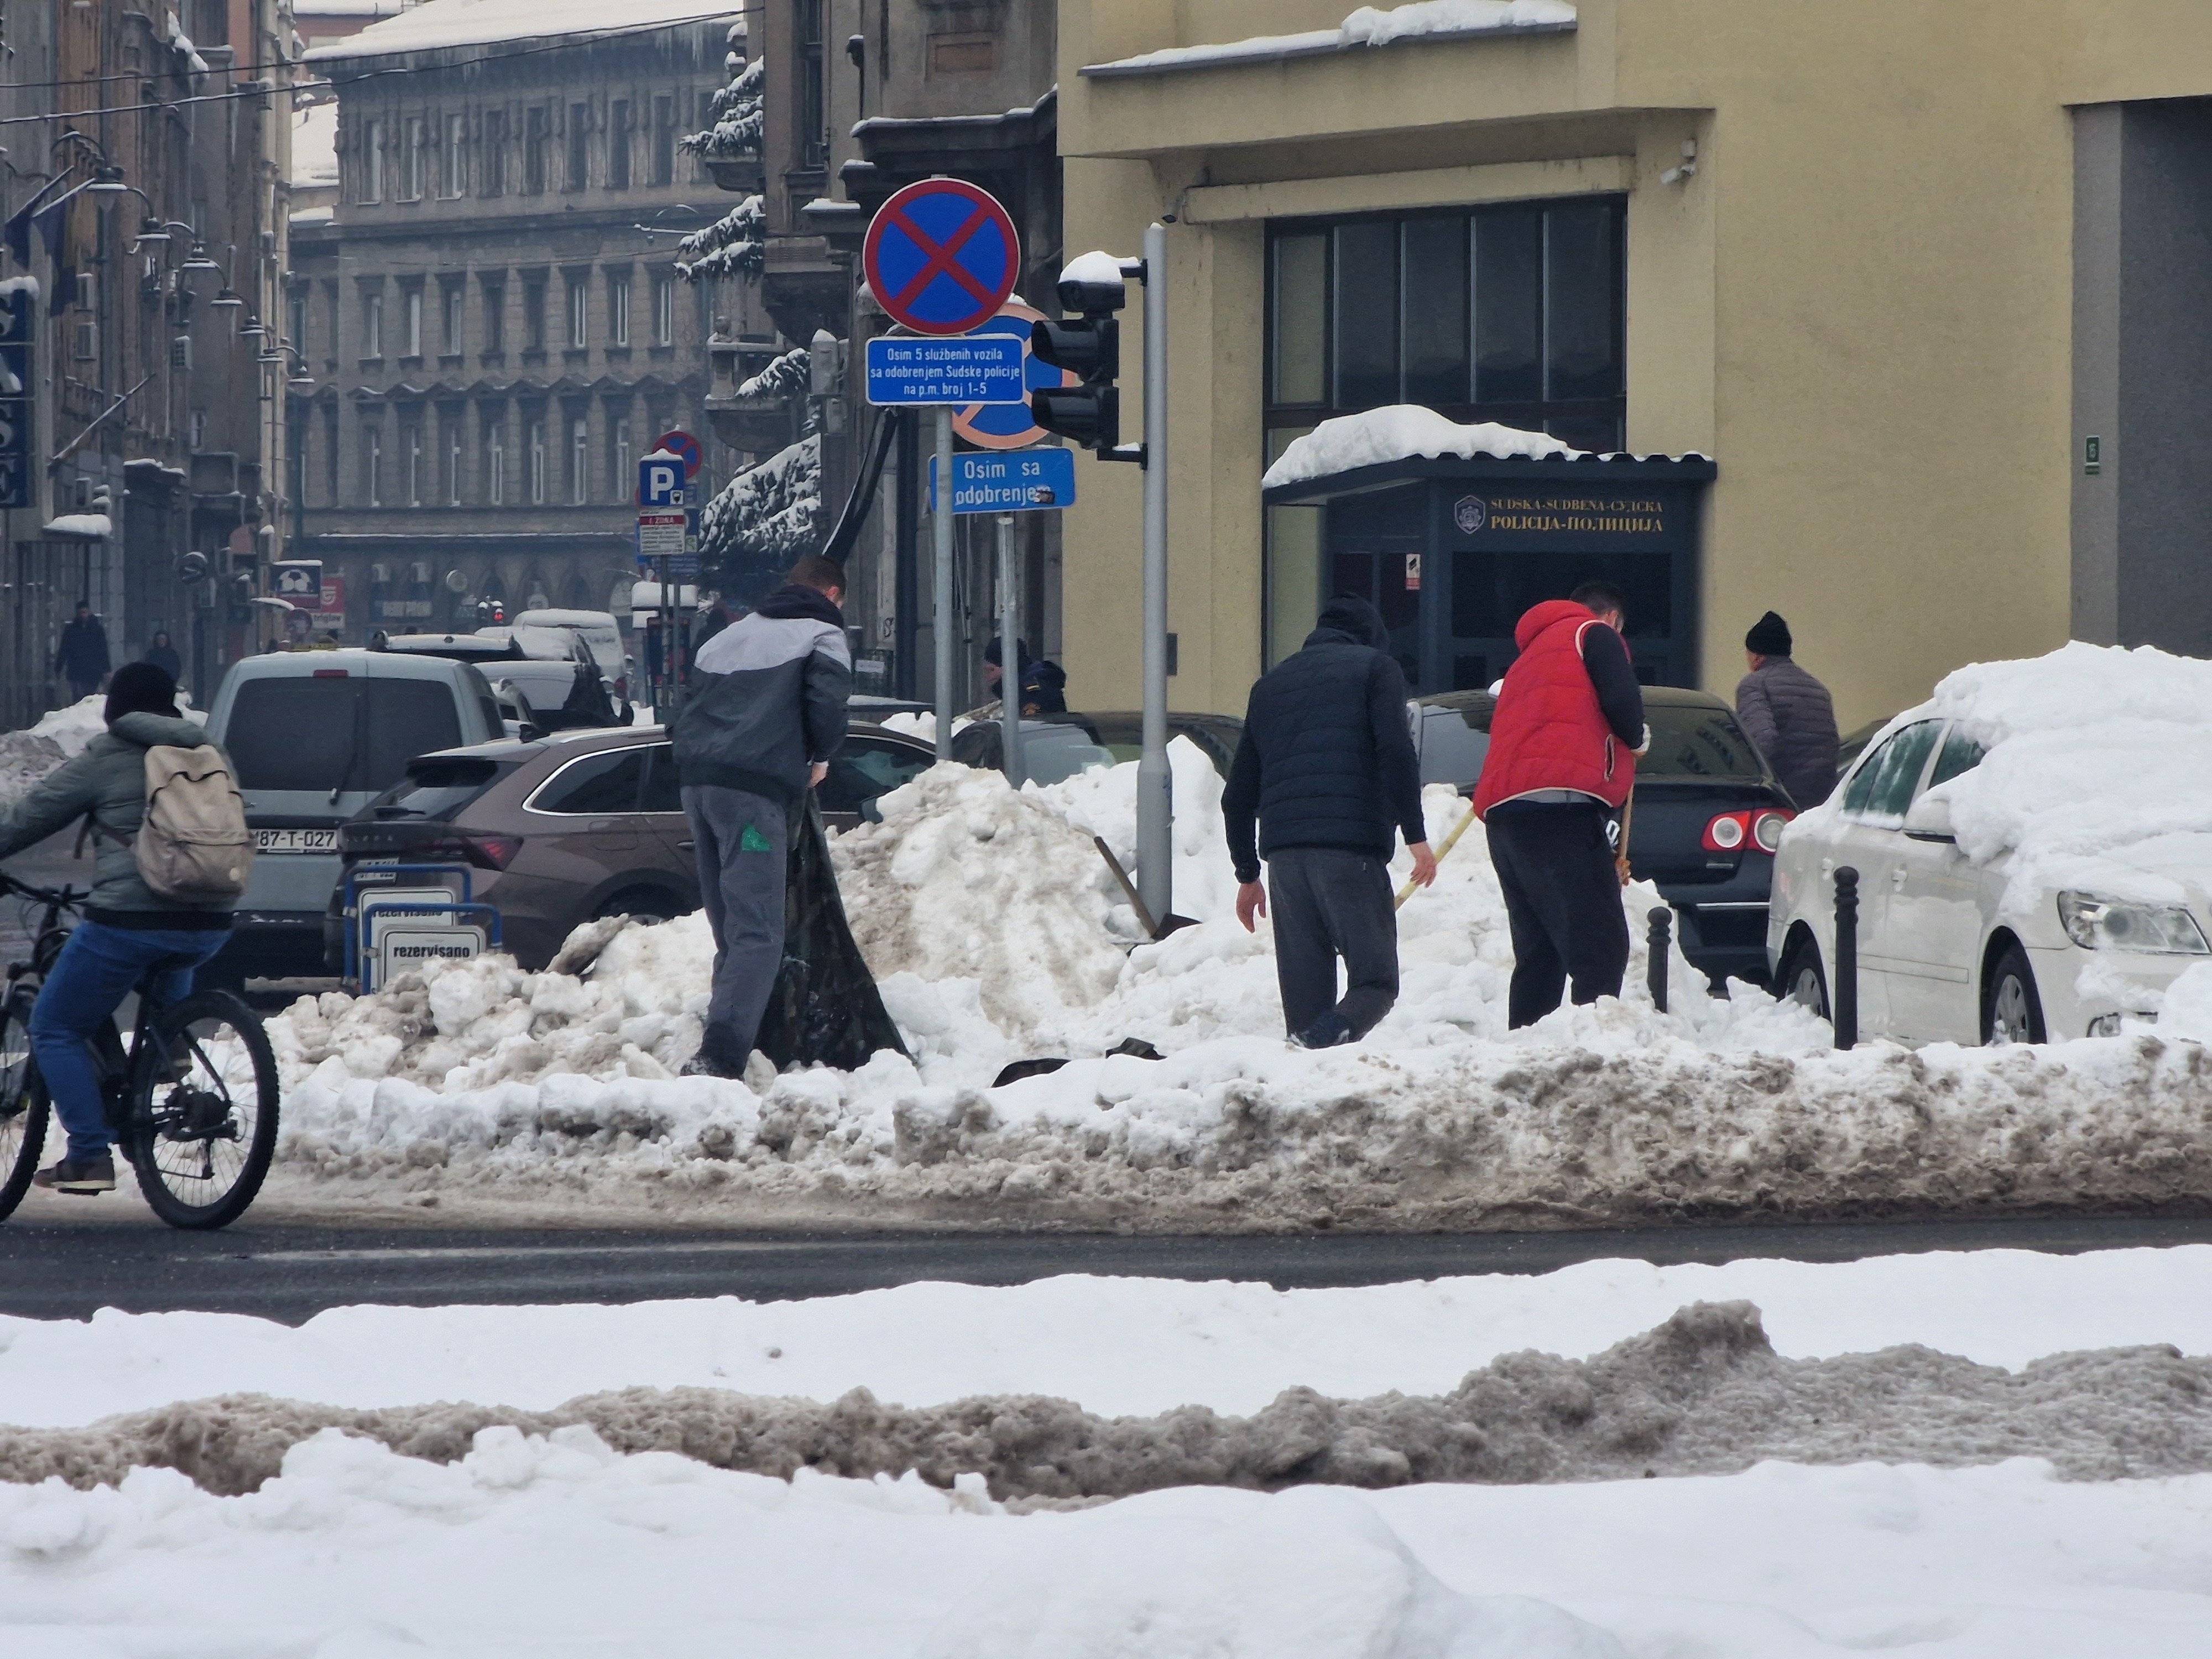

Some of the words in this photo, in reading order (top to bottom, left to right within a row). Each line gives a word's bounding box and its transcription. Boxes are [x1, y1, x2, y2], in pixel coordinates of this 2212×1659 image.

[887, 348, 912, 361] Osim
[915, 348, 922, 361] 5
[925, 347, 971, 361] službenih
[974, 348, 1003, 360] vozila
[870, 368, 882, 378] sa
[885, 365, 943, 381] odobrenjem
[946, 365, 982, 378] Sudske
[984, 365, 1020, 380] policije
[904, 385, 916, 395] na
[942, 382, 963, 398] broj
[968, 382, 987, 394] 1-5
[964, 460, 1006, 479] Osim
[1021, 462, 1040, 476] sa
[650, 466, 675, 500] P
[255, 831, 335, 847] 87-T-027
[393, 944, 470, 958] rezervisano
